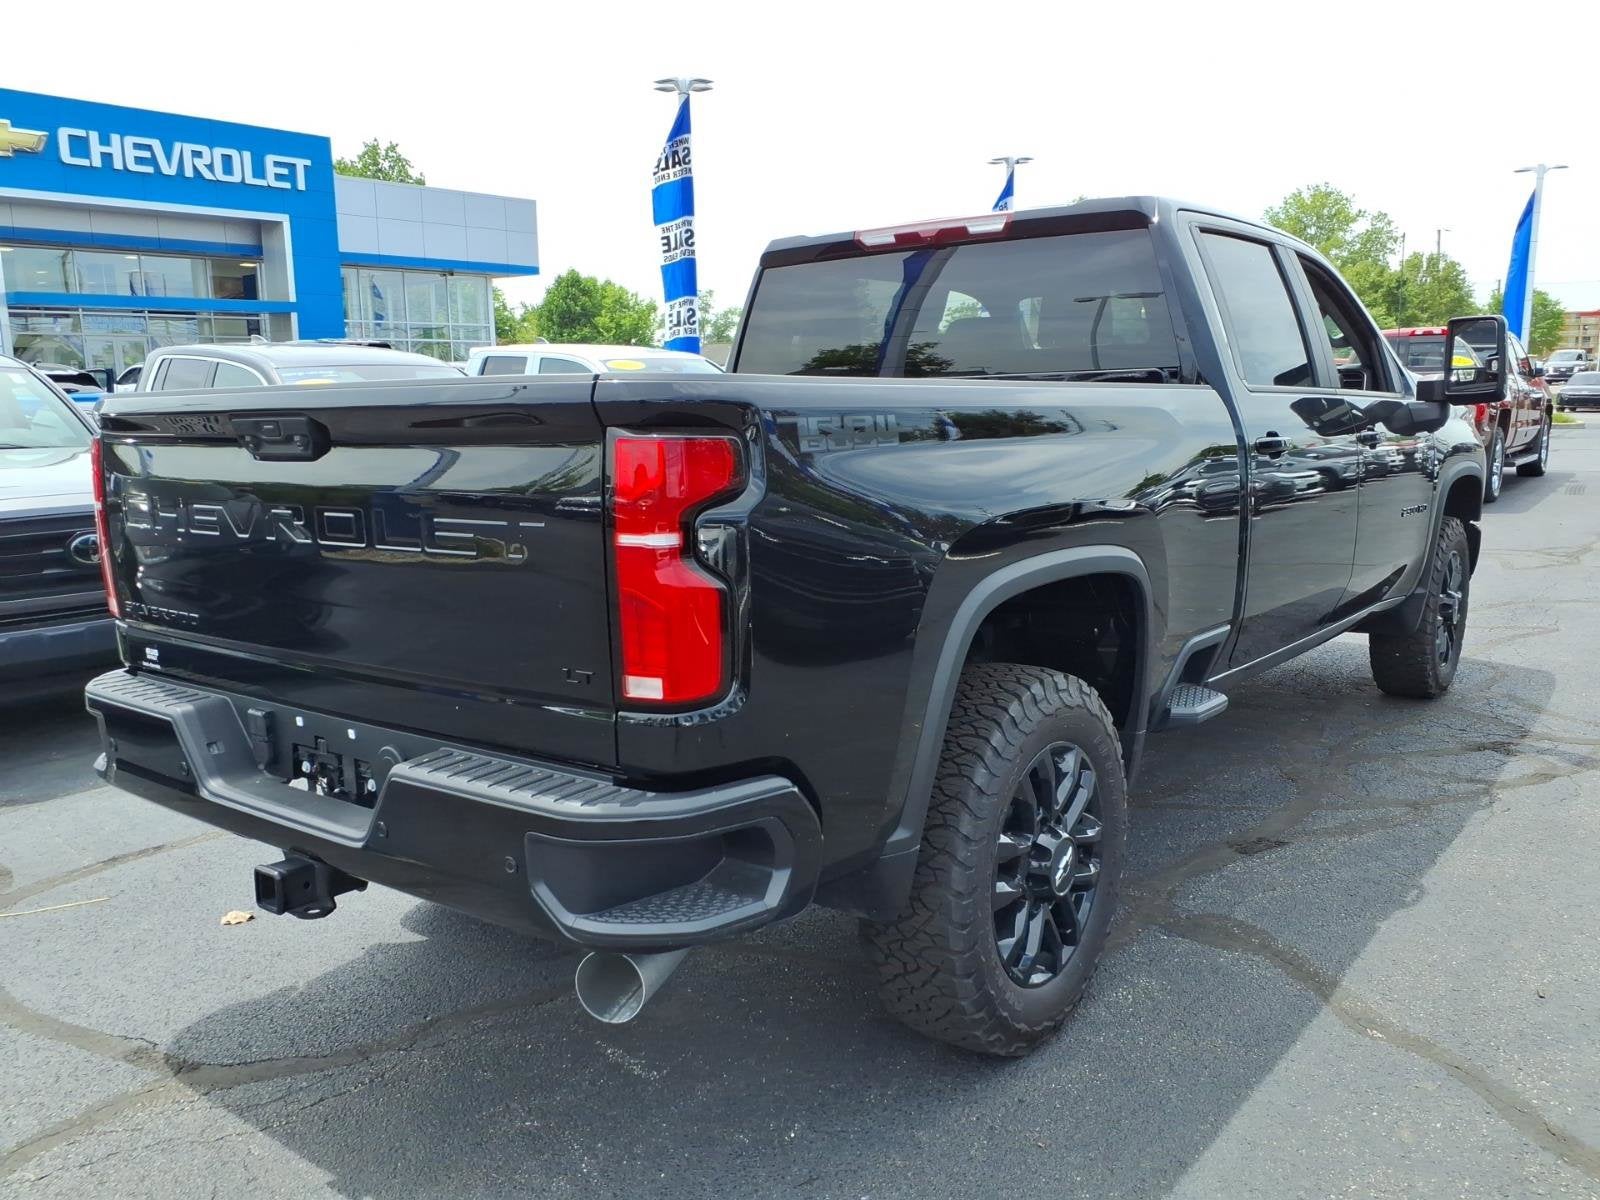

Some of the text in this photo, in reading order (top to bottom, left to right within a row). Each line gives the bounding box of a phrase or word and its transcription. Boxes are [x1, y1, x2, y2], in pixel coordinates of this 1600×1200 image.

[57, 126, 312, 191] CHEVROLET
[124, 491, 546, 560] CHEVROLET
[561, 667, 596, 685] LT
